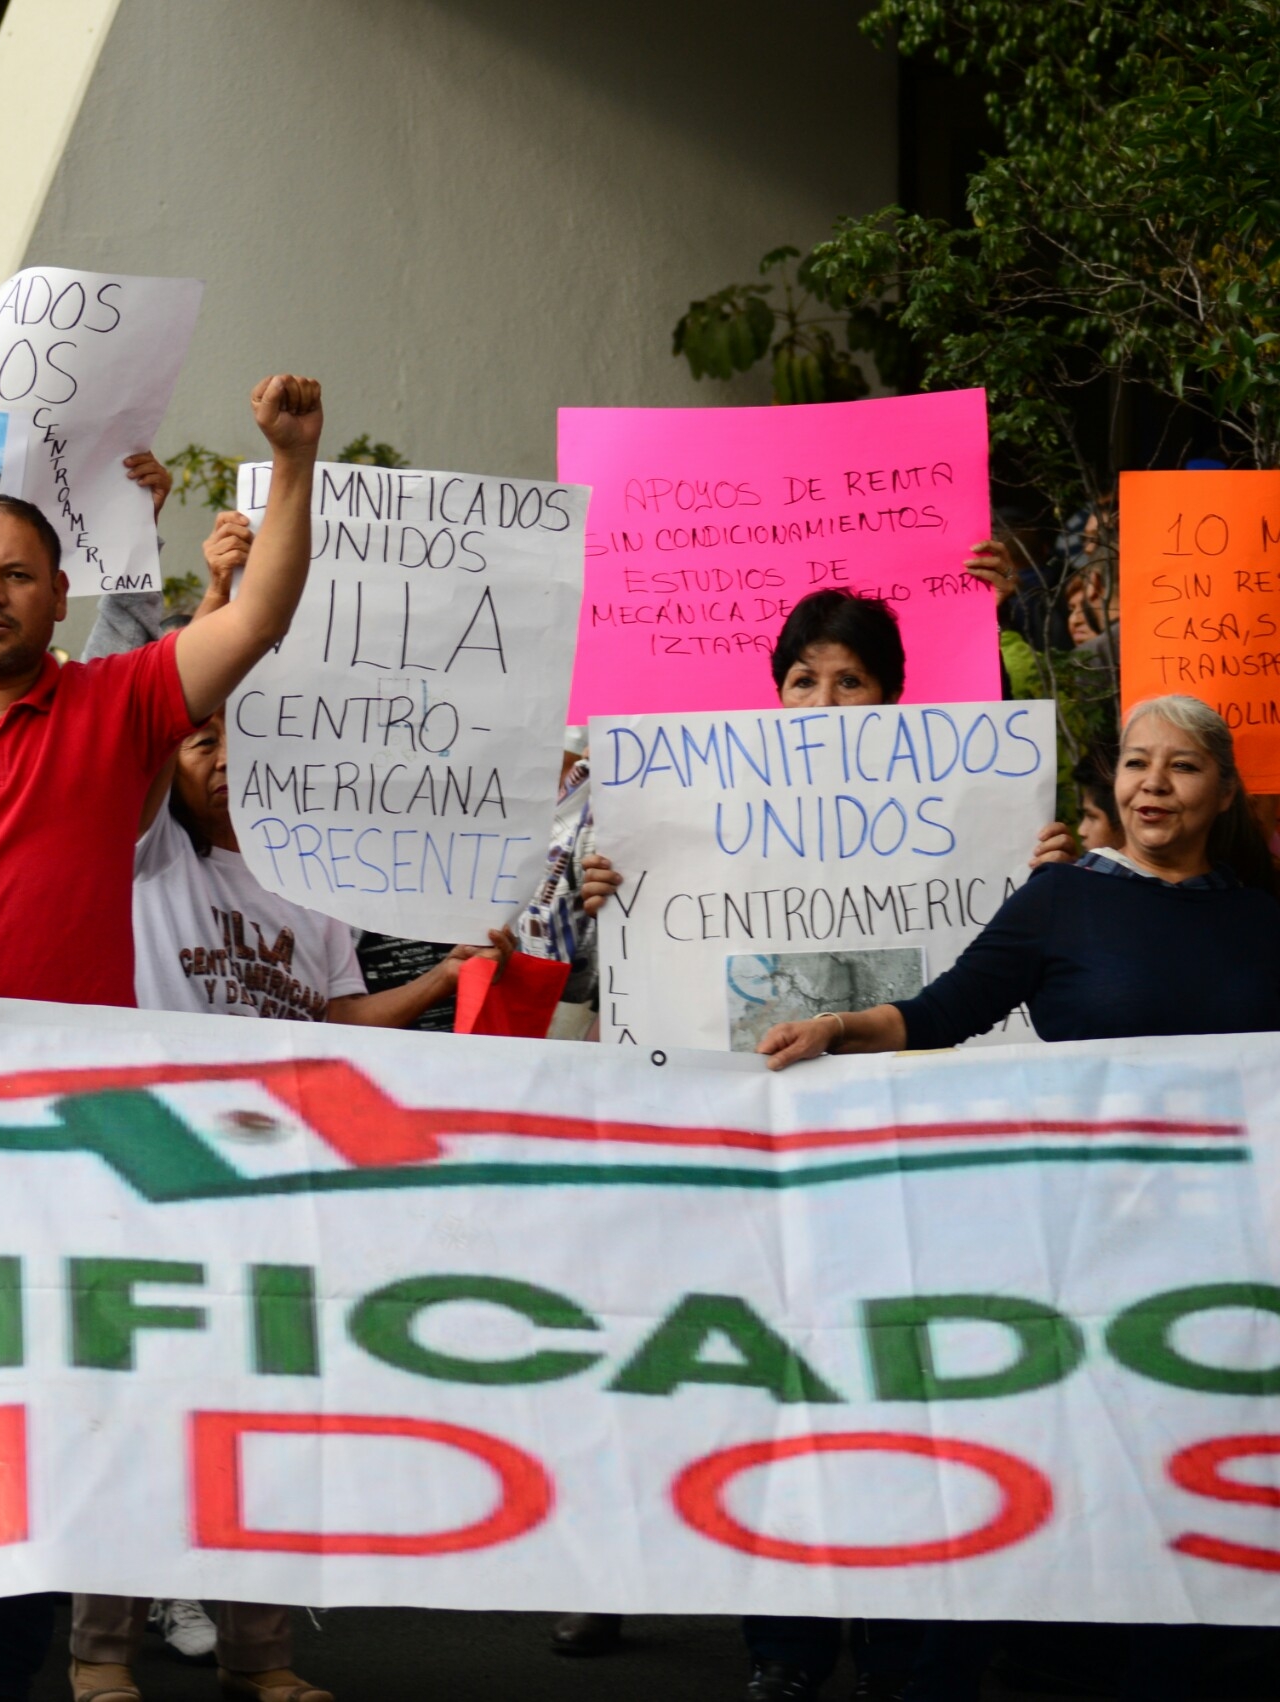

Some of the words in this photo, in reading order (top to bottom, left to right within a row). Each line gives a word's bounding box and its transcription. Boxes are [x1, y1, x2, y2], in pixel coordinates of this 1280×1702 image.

[247, 465, 573, 532] DMNIFICADOS
[624, 478, 763, 514] APOYOS
[782, 476, 826, 507] DE
[845, 461, 954, 498] RENTA
[584, 532, 644, 558] SIN
[1162, 512, 1230, 557] 10
[623, 566, 787, 595] ESTUDIOS
[806, 558, 850, 586] DE
[1149, 573, 1213, 604] SIN
[1234, 570, 1280, 594] RE
[272, 578, 508, 674] ILLA
[592, 598, 745, 628] MECÁNICA
[754, 598, 792, 622] DE
[651, 633, 778, 657] IZTAPA
[235, 690, 493, 754] CENTRO-
[600, 707, 1043, 791] DAMNIFICADOS
[241, 760, 508, 820] AMERICANA
[715, 794, 958, 862] UNIDOS
[250, 816, 533, 906] PRESENTE
